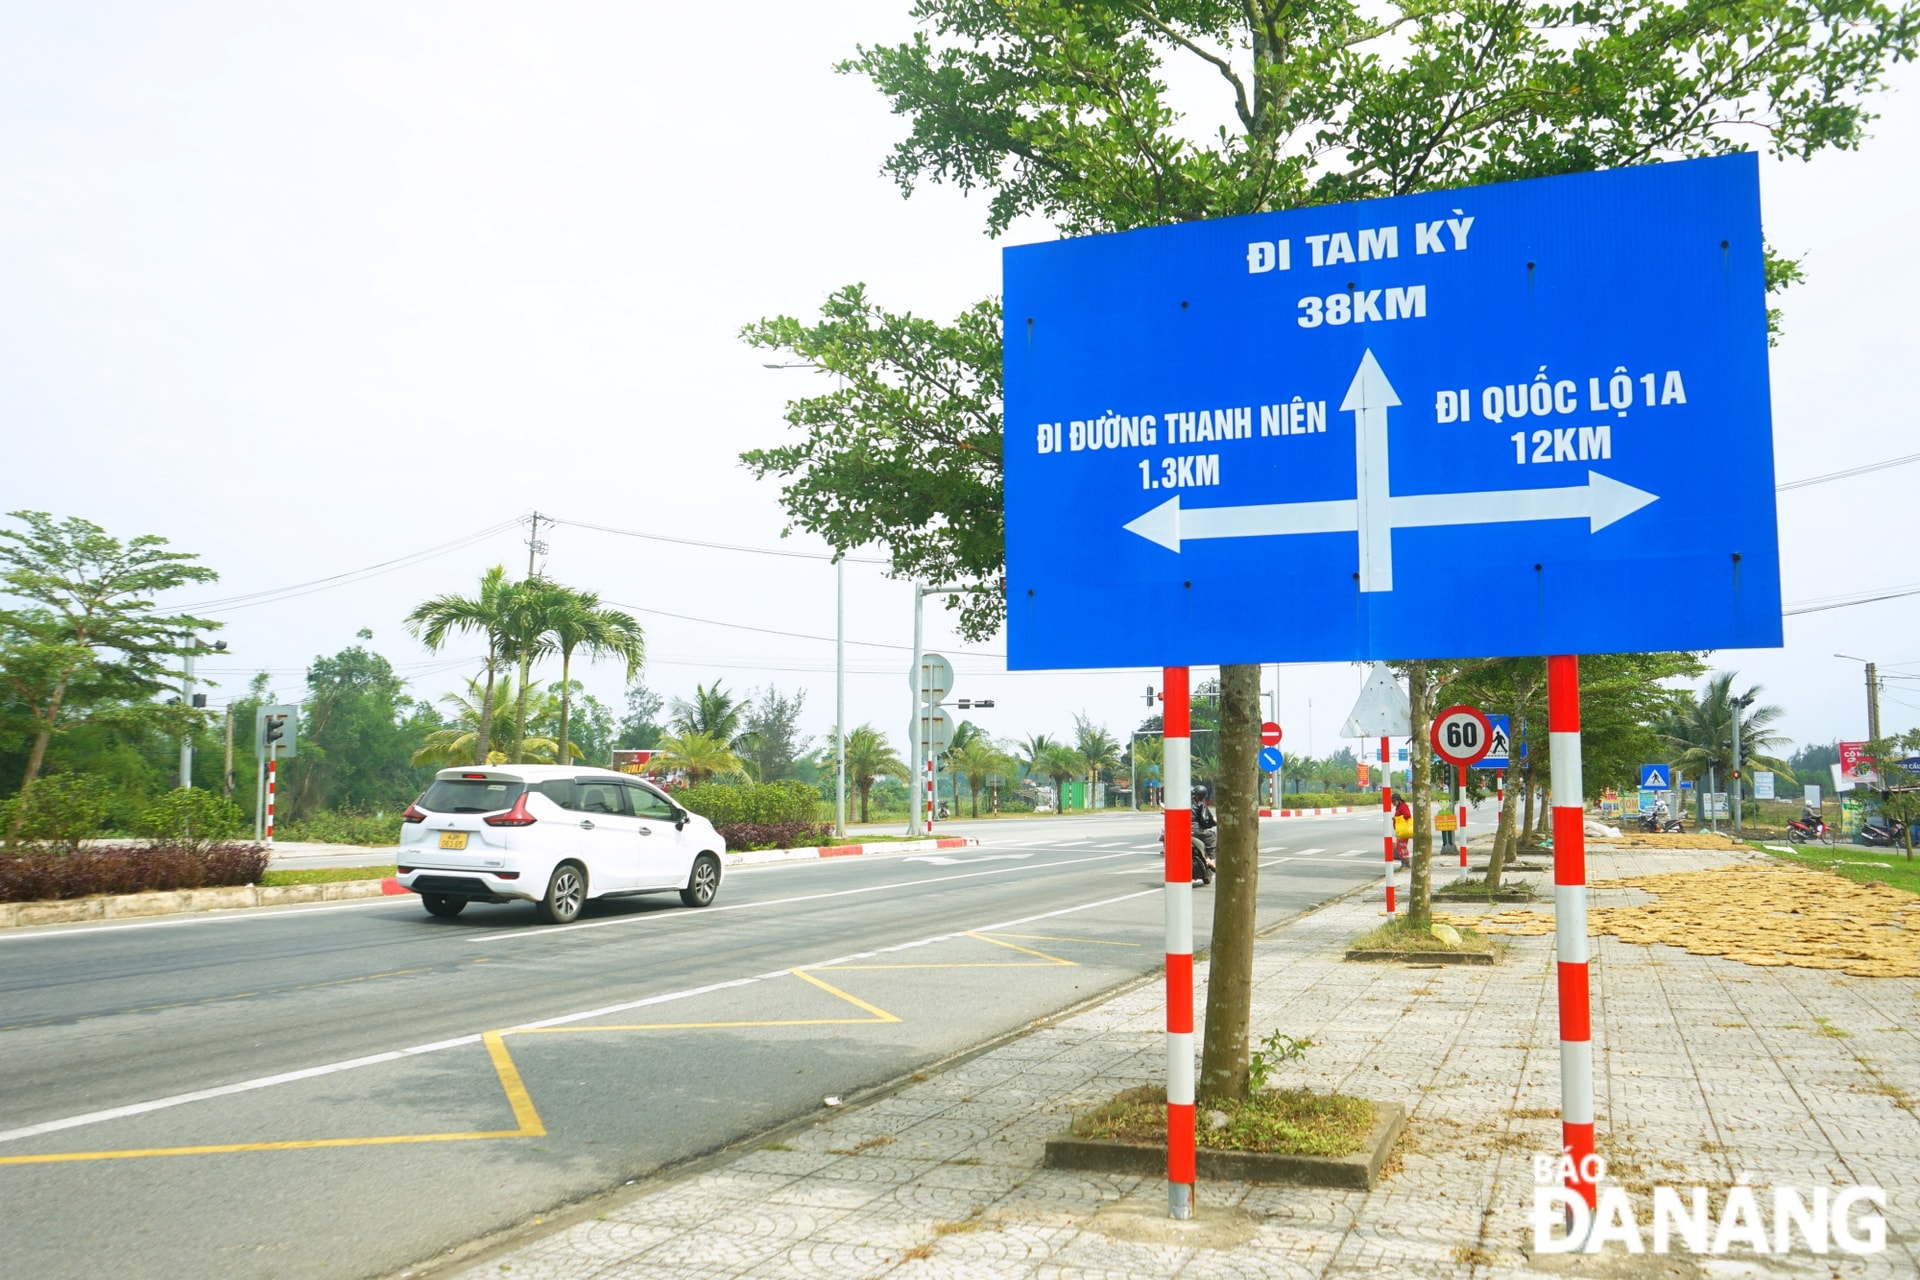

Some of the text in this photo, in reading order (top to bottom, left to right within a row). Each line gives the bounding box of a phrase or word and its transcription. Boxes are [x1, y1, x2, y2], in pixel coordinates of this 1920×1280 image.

[1246, 208, 1475, 274] ĐI TAM KỲ
[1297, 285, 1427, 329] 38KM
[1435, 365, 1687, 424] ĐI QUỐC LỘ 1A
[1036, 395, 1327, 454] ĐI ĐƯỜNG THANH NIÊN
[1510, 425, 1611, 465] 12KM
[1138, 454, 1220, 490] 1.3KM
[1447, 722, 1477, 748] 60
